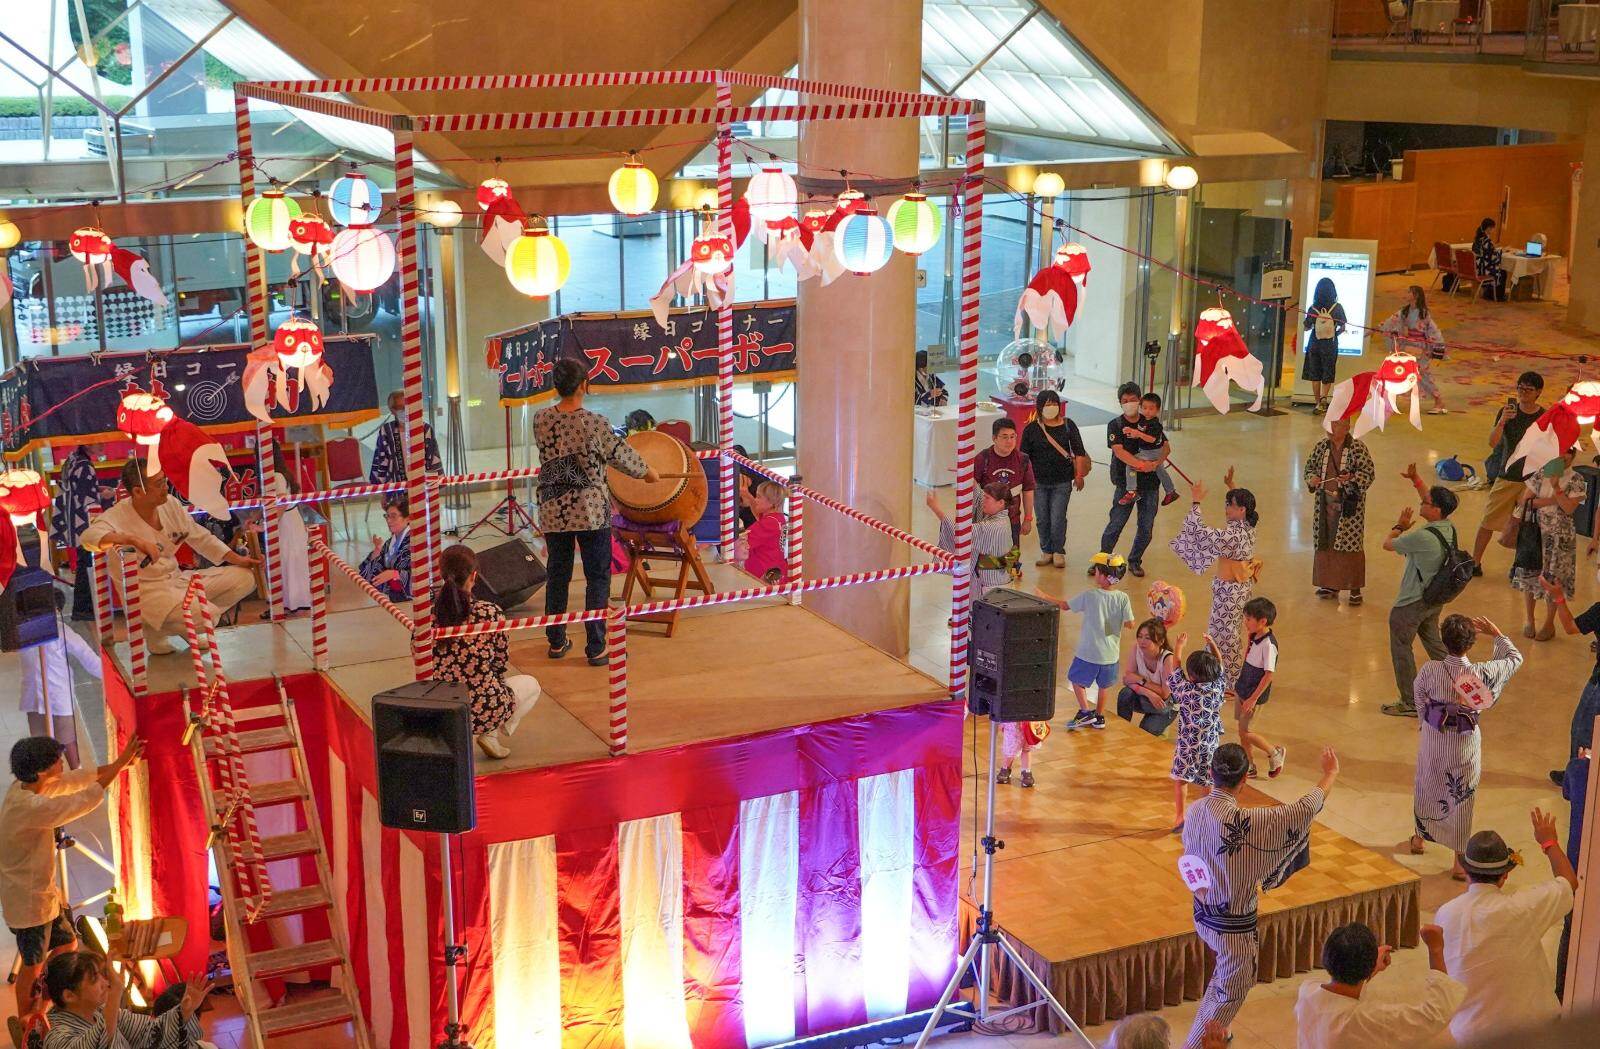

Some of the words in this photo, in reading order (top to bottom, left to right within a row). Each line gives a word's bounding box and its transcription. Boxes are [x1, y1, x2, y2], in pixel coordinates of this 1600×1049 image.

[633, 314, 784, 341] 縁日コナー
[583, 331, 797, 381] スーパーボー
